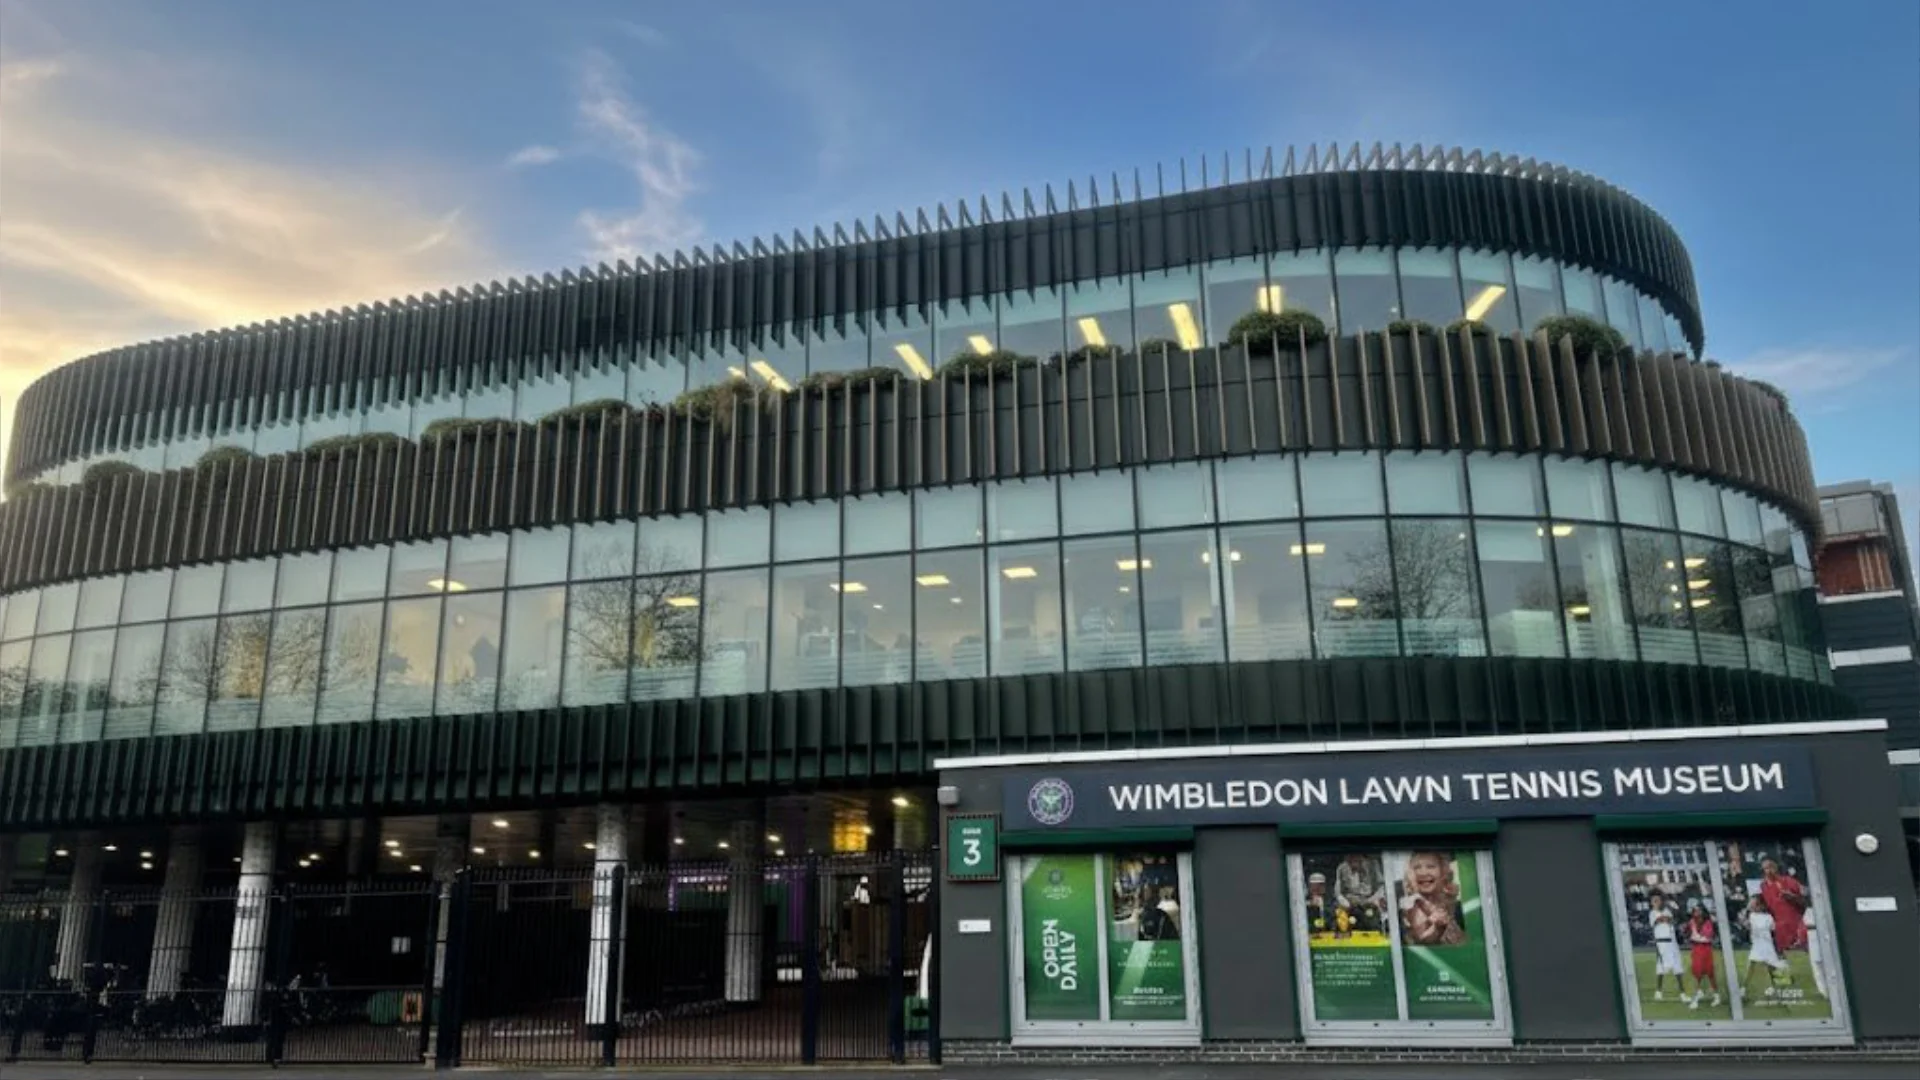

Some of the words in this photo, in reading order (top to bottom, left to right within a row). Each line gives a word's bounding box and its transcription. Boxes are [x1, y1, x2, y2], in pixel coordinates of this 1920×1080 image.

[1108, 778, 1329, 811] WIMBLEDON
[1339, 774, 1452, 805] LAWN
[1462, 768, 1603, 801] TENNIS
[1613, 762, 1785, 796] MUSEUM
[963, 838, 981, 866] 3
[1042, 919, 1060, 978] OPEN
[1060, 931, 1078, 991] DAILY
